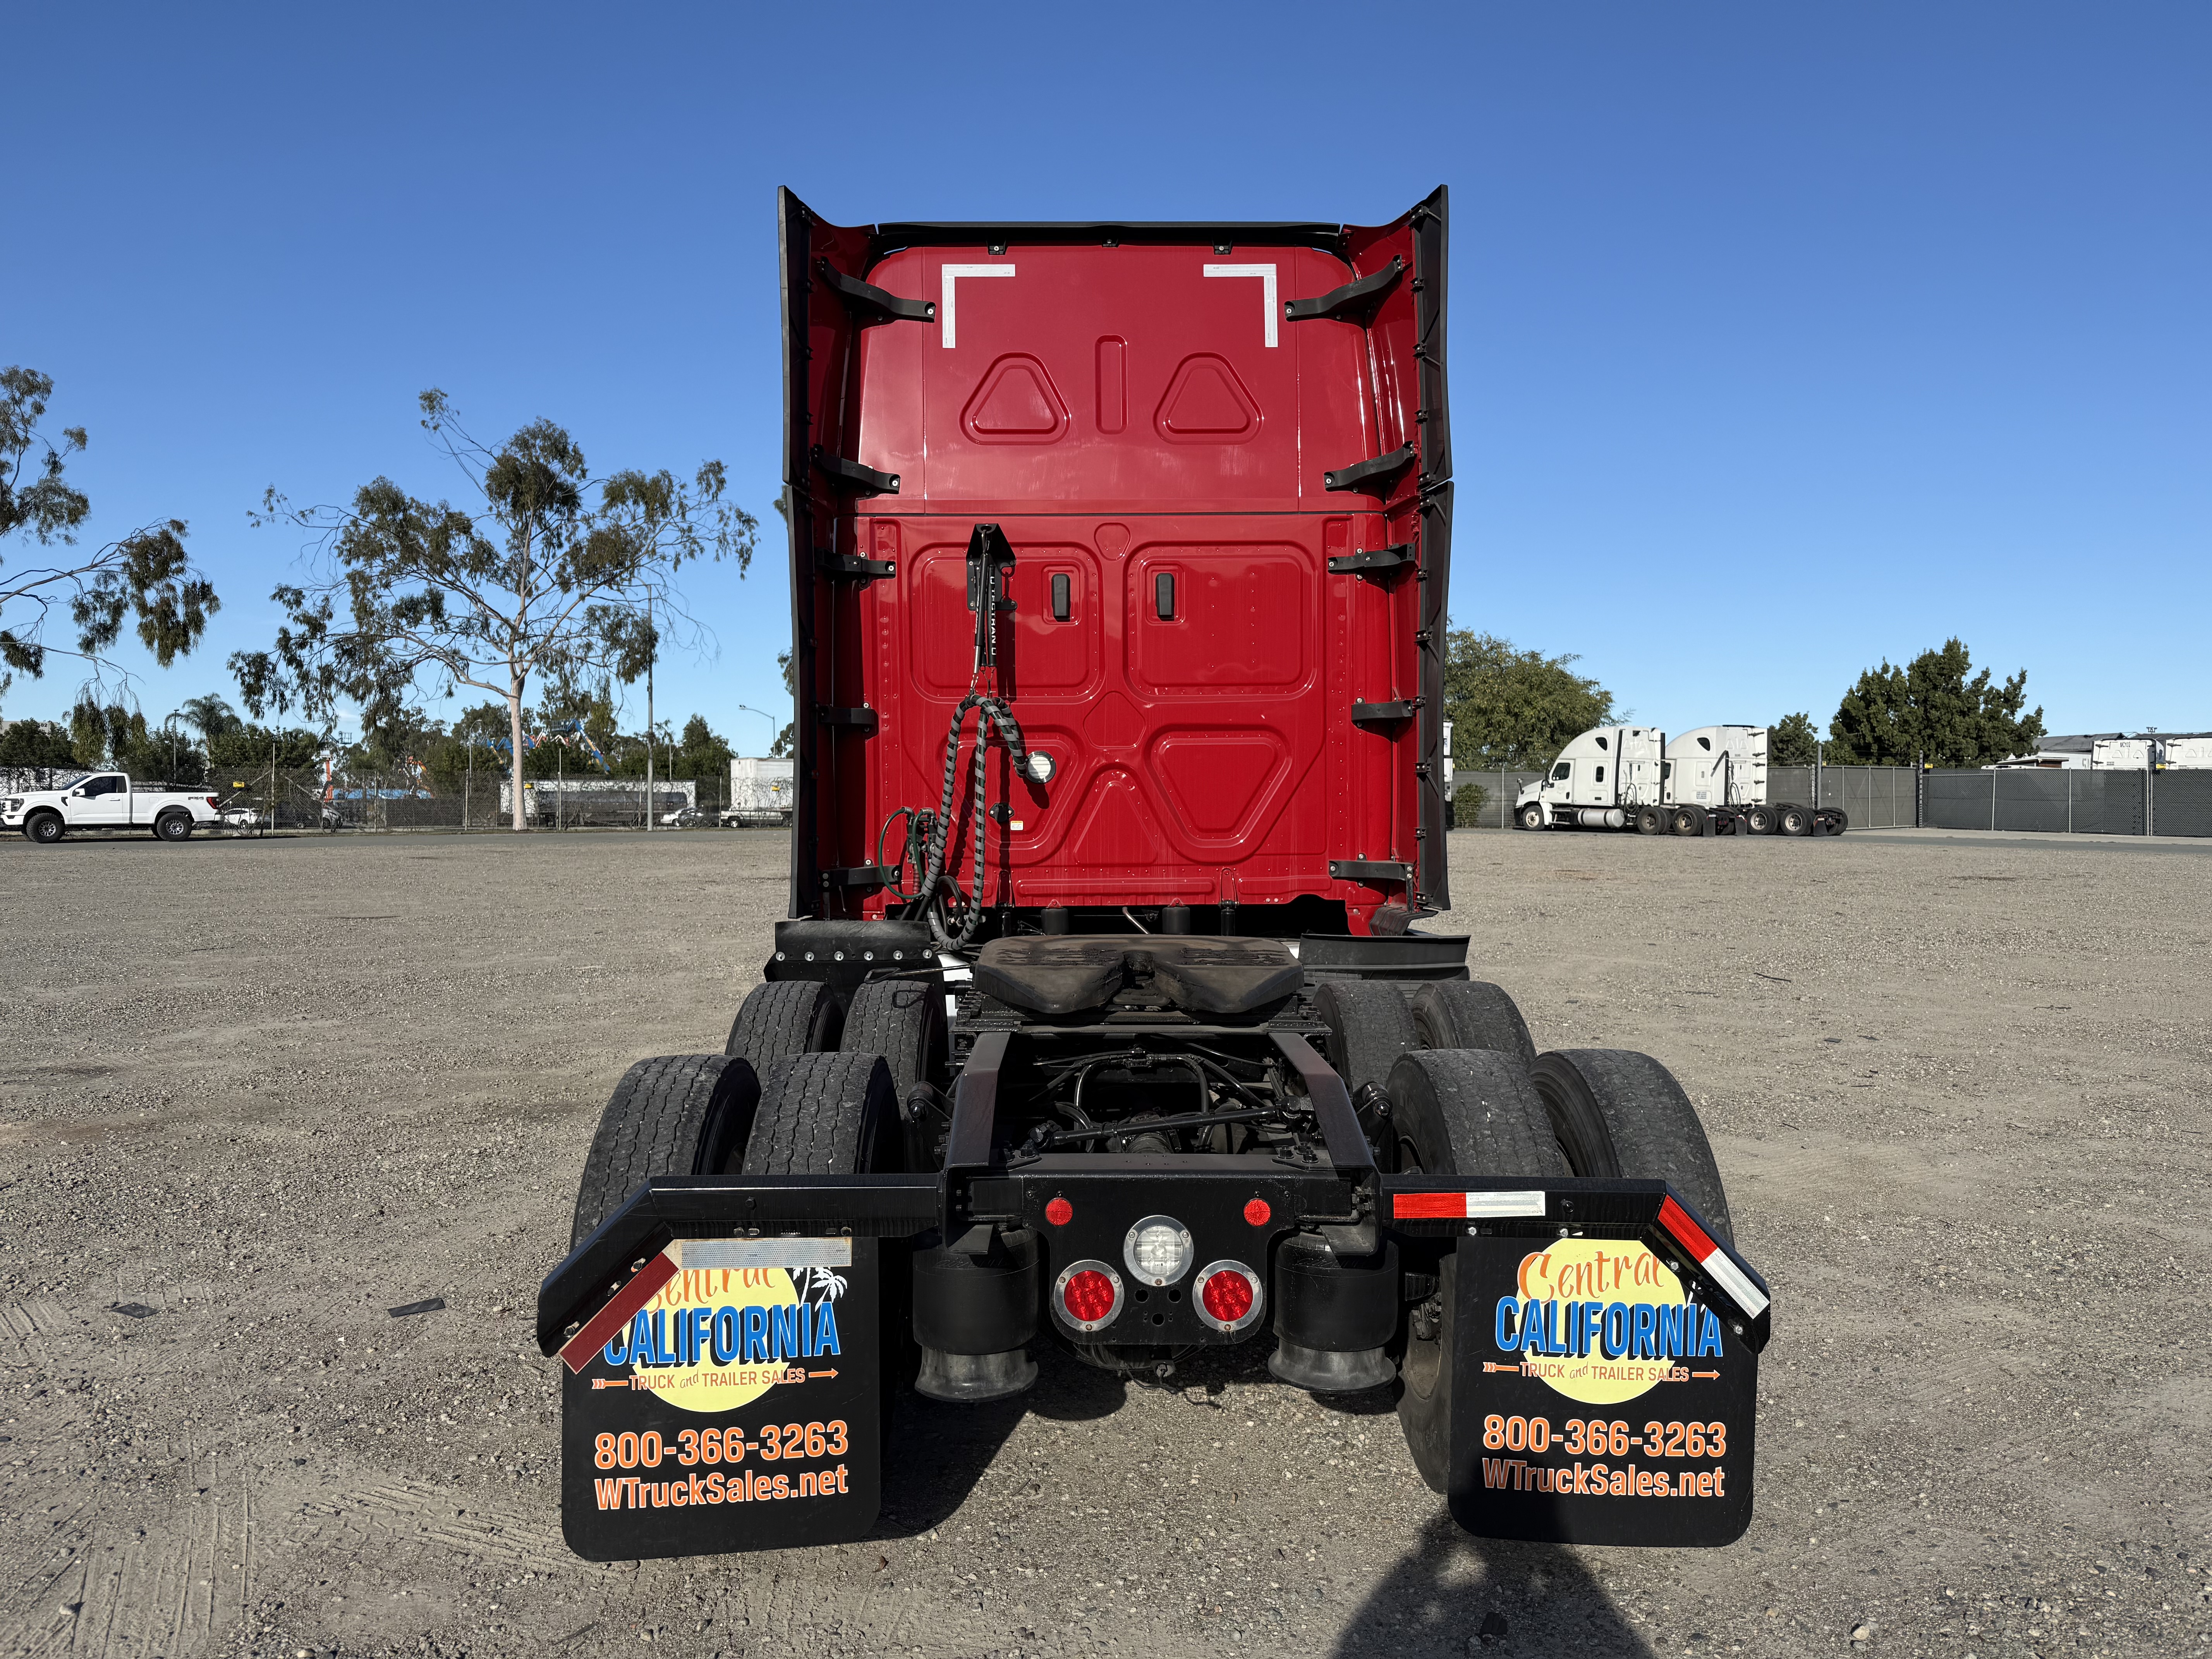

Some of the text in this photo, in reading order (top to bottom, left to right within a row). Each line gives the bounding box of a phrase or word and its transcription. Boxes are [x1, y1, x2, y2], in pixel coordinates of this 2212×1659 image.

[1517, 1251, 1664, 1304] Central
[1495, 1296, 1723, 1357] CALIFORNIA
[629, 1368, 805, 1390] TRUCK and TRAILER SALES
[1520, 1361, 1689, 1382] TRUCK and TRAILER SALES
[594, 1420, 848, 1469] 800-366-3263
[1483, 1414, 1726, 1457] 800-366-3263
[595, 1464, 848, 1510] WTruckSales.net
[1482, 1456, 1725, 1498] WTruckSales.net
